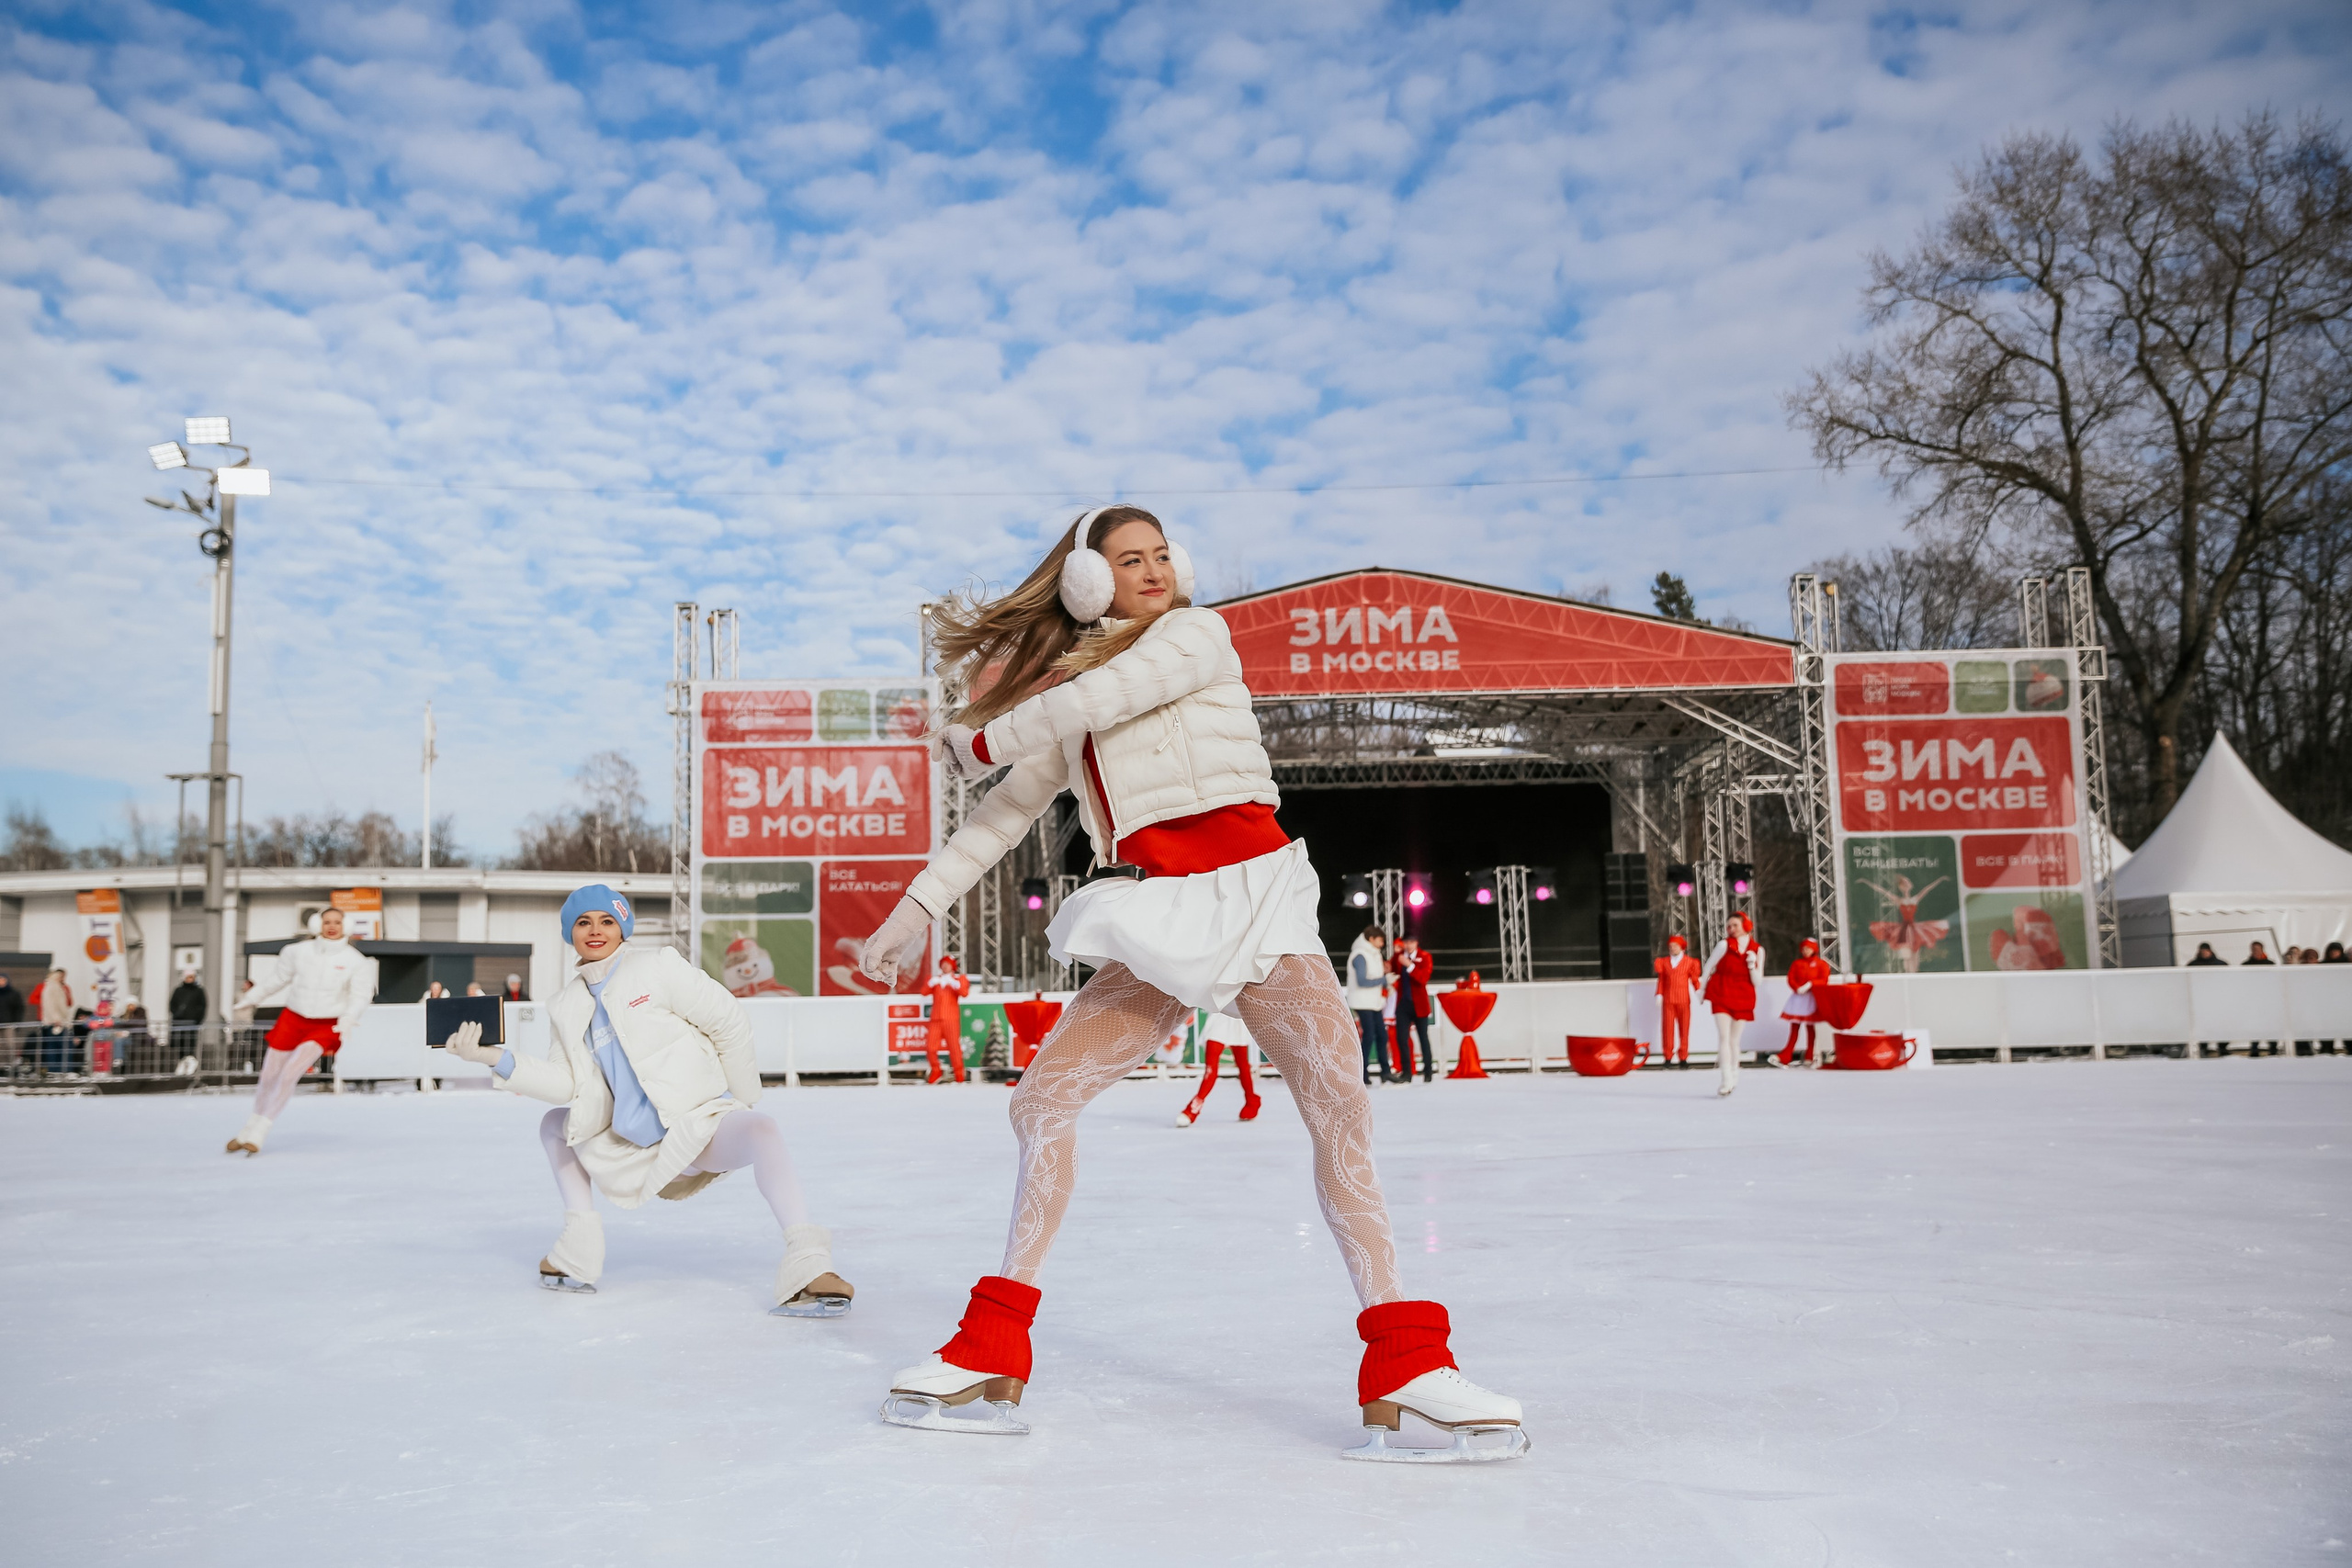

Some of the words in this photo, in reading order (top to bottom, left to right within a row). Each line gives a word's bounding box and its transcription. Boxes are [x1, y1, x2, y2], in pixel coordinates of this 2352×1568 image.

[1289, 605, 1458, 647] ЗИМА
[1290, 652, 1311, 673] В
[1322, 649, 1460, 673] МОСКВЕ
[1861, 738, 2046, 782] ЗИМА
[727, 765, 907, 808] ЗИМА
[1864, 789, 1886, 812] В
[1898, 785, 2048, 811] МОСКВЕ
[727, 815, 750, 838] В
[762, 813, 907, 838] МОСКВЕ
[1853, 846, 1881, 857] ВСЕ
[1853, 857, 1939, 868] ТАНЦЕВАТЬ!
[1975, 855, 2005, 866] ВСЕ
[2007, 855, 2020, 866] В
[829, 869, 857, 880] ВСЕ
[757, 882, 800, 893] ПАРК!
[829, 881, 902, 892] КАТАТЬСЯ!
[896, 1025, 929, 1039] ЗИМ
